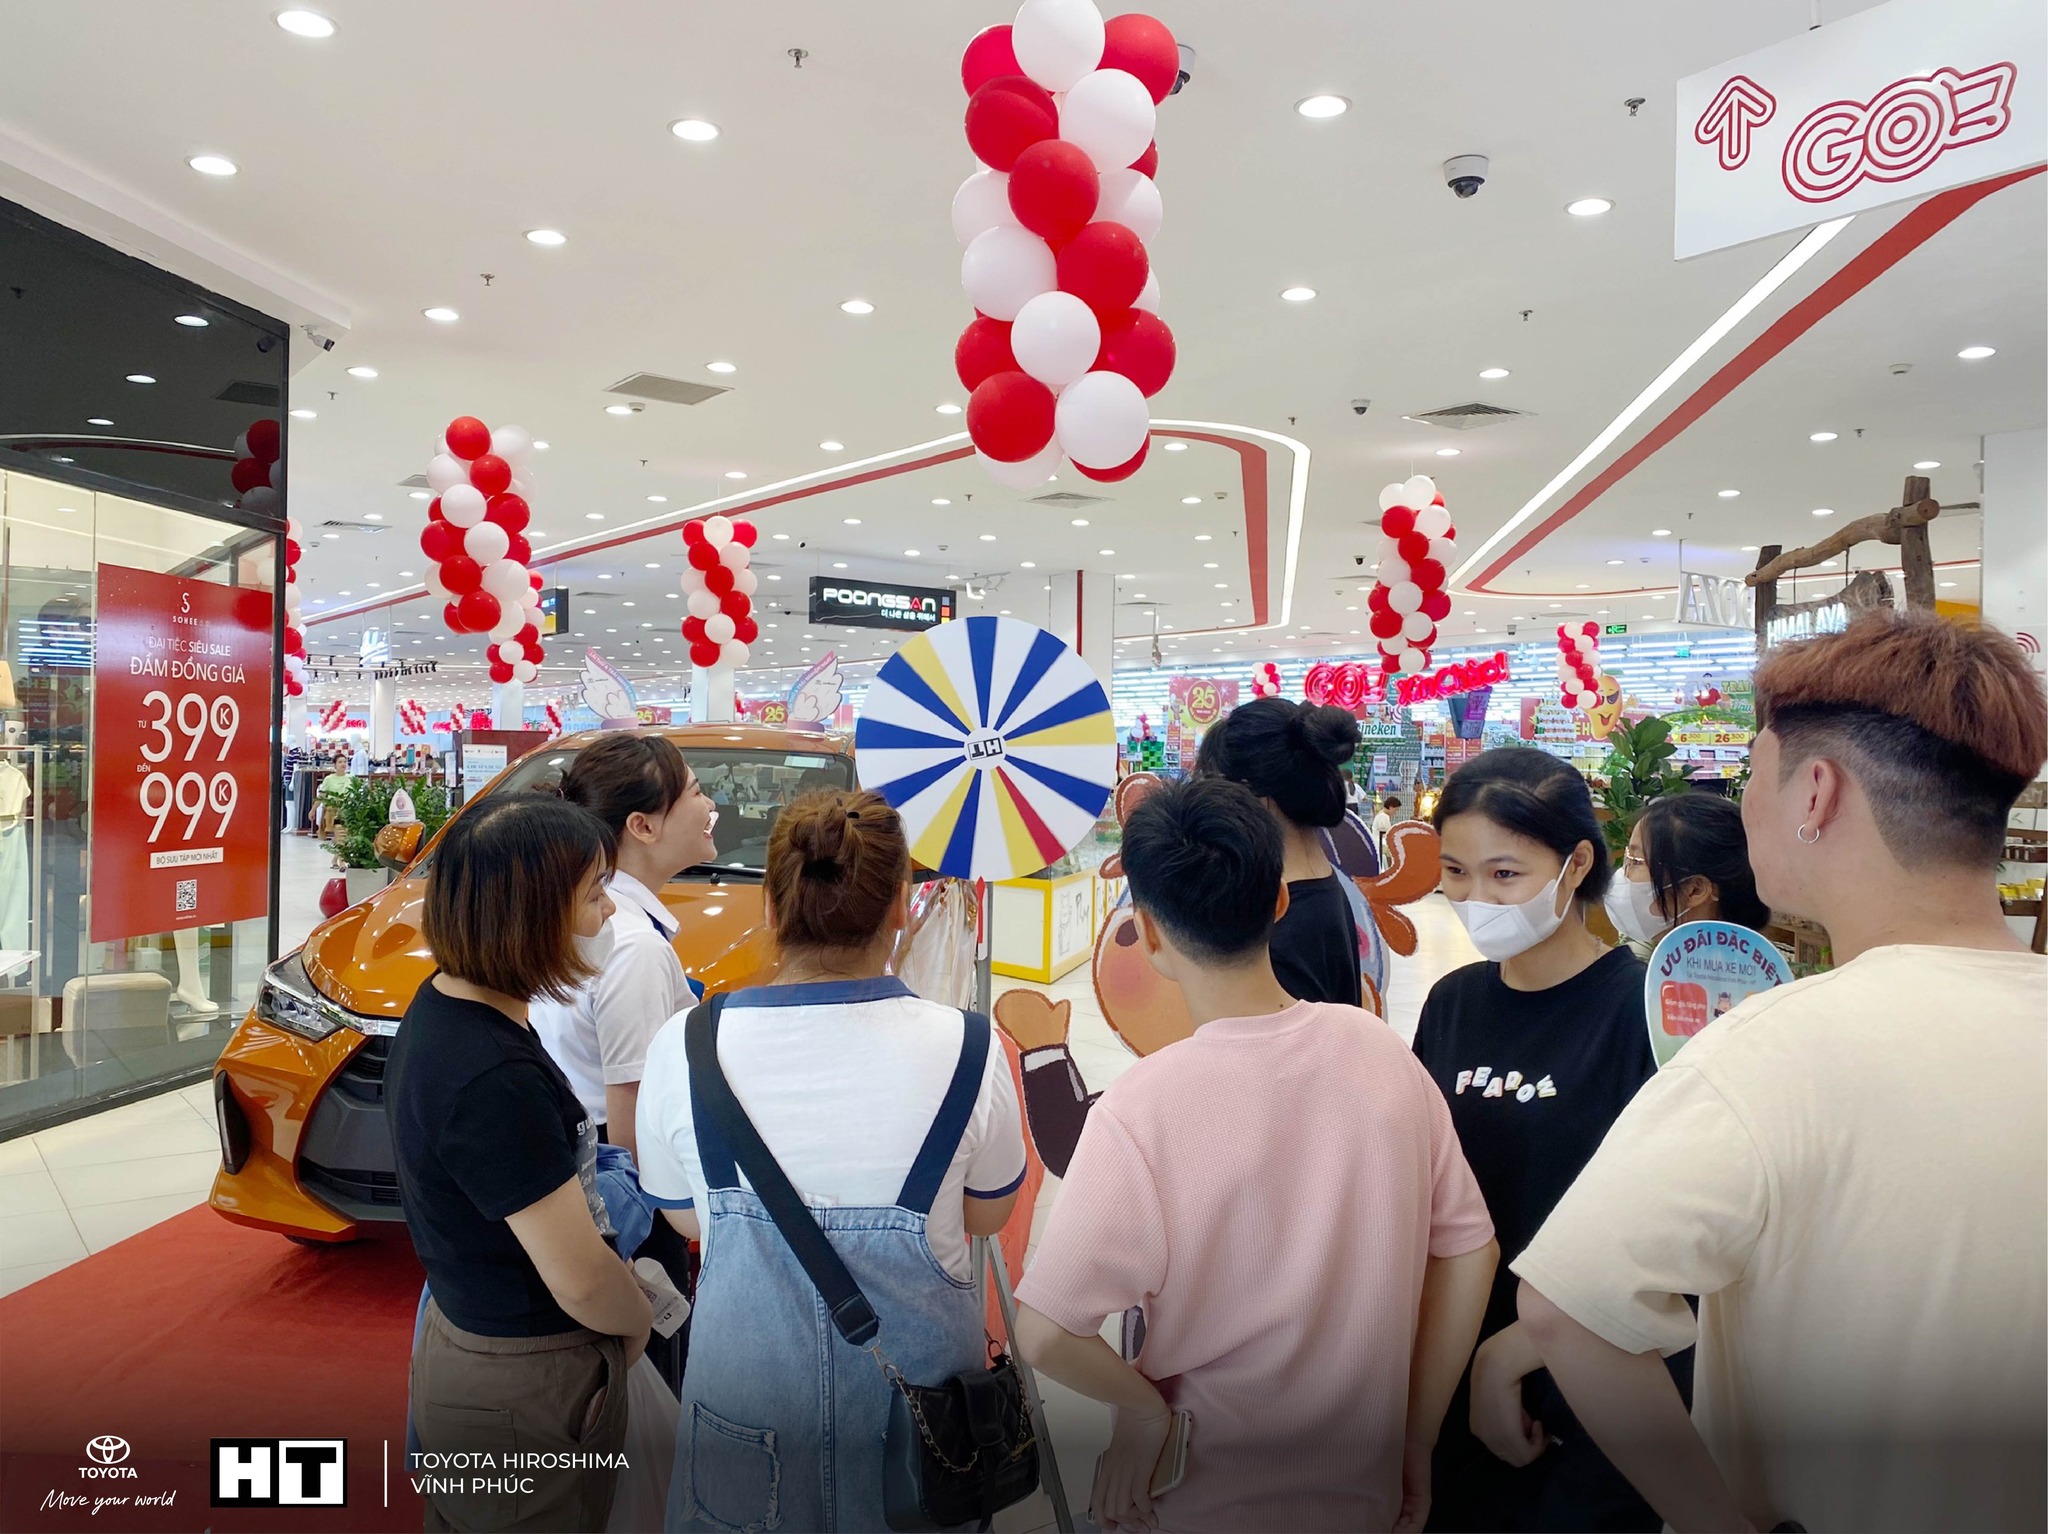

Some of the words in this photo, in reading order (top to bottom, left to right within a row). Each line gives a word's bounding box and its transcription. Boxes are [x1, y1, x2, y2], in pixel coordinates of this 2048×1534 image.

[823, 587, 936, 612] POONGSAN
[172, 615, 198, 626] SOHEE
[188, 639, 208, 654] SIÊU
[210, 643, 231, 656] SALE
[130, 652, 168, 678] ĐẦM
[171, 656, 217, 682] ĐỒNG
[221, 663, 246, 684] GIÁ
[1192, 685, 1216, 709] 25
[139, 690, 240, 763] 399
[136, 762, 151, 773] ĐẾN
[139, 771, 239, 844] 999
[1660, 946, 1682, 977] ƯU
[1683, 929, 1712, 955] ĐÃI
[1715, 929, 1750, 955] ĐẶC
[1686, 956, 1702, 969] KHI
[1703, 959, 1723, 973] MUA
[1725, 962, 1737, 974] XE
